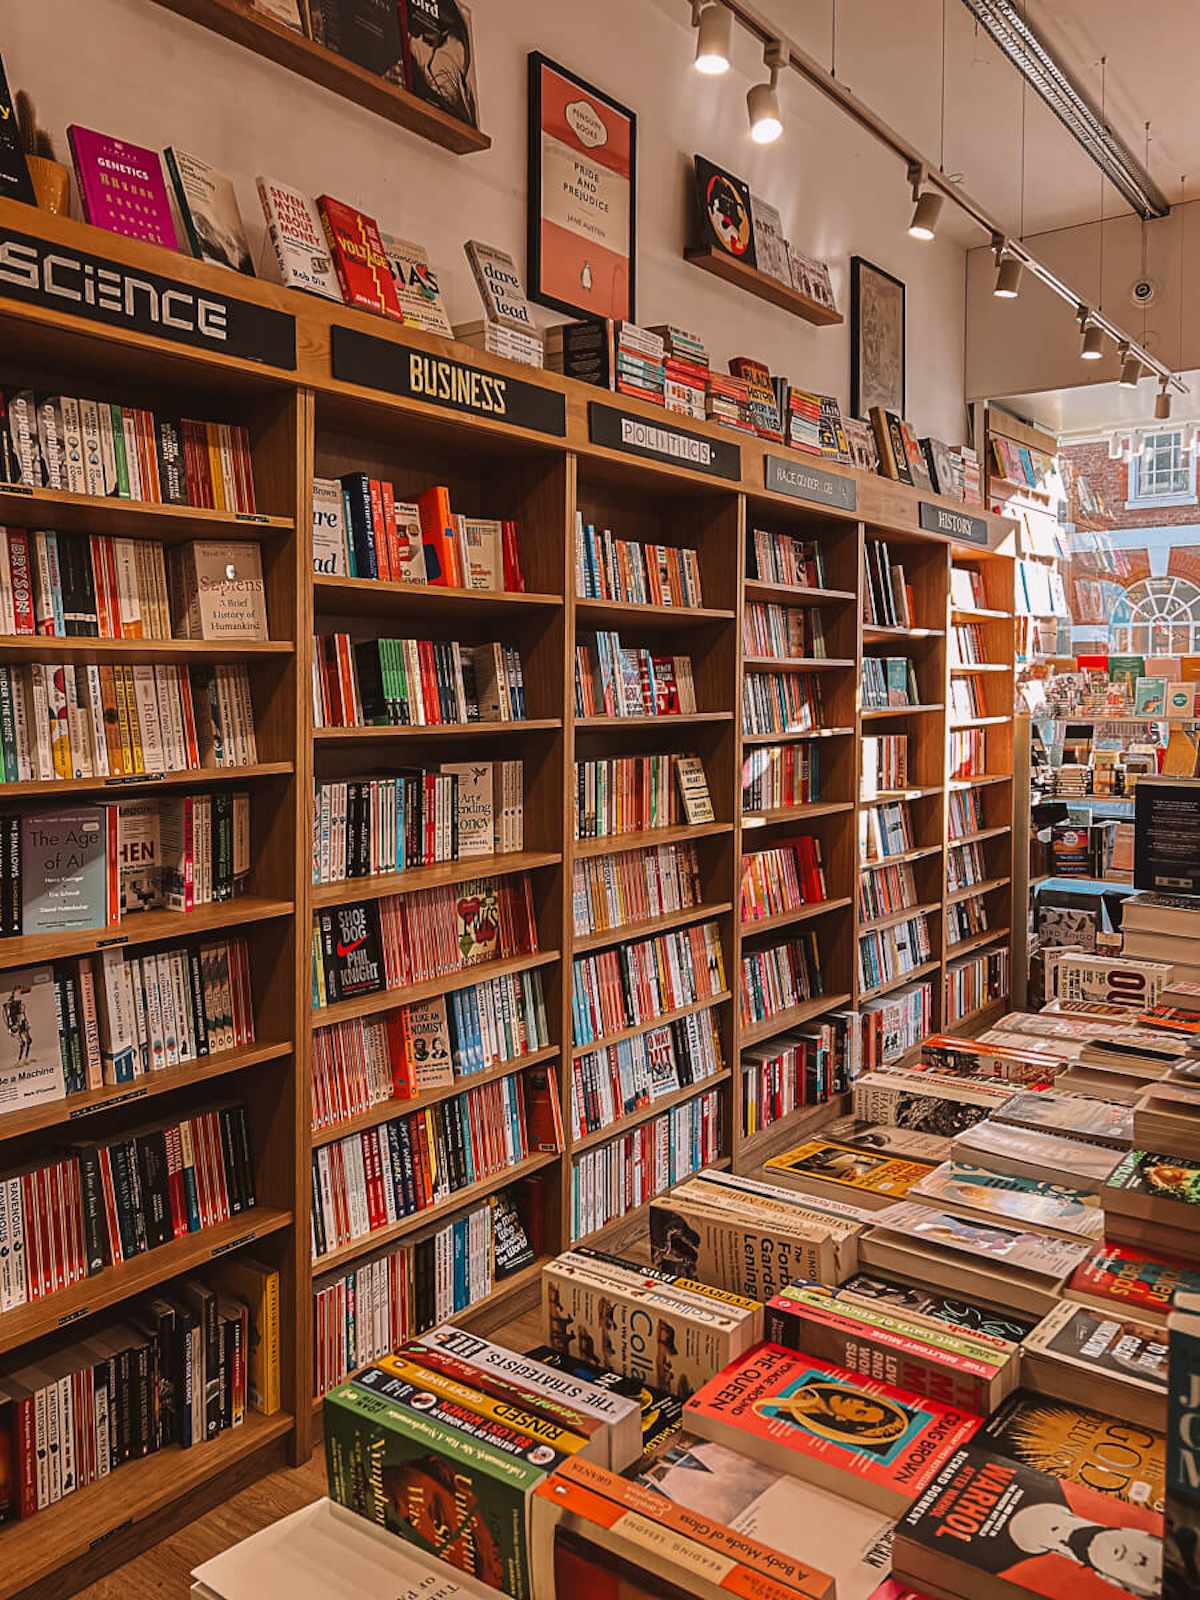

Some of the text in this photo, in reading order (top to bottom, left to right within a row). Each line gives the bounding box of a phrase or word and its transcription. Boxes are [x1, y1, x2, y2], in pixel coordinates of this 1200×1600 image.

[572, 107, 602, 131] PENGUIN
[575, 121, 598, 140] BOOKS
[97, 157, 149, 181] GENETICS
[574, 162, 600, 183] PRIDE
[270, 186, 305, 210] SEVEN
[563, 182, 610, 214] PREJUDICE
[577, 176, 597, 194] AND
[273, 199, 312, 223] MYTHS
[277, 211, 314, 235] ABOUT
[280, 222, 320, 247] MONEY
[567, 213, 606, 238] JANE AUSTEN
[337, 235, 391, 271] VOLTAGE
[484, 262, 521, 289] dare
[489, 279, 505, 297] to
[496, 297, 530, 323] lead
[409, 353, 507, 415] BUSINESS
[14, 398, 35, 486] oppenheimer
[41, 403, 62, 490] oppenheimer
[623, 420, 711, 465] POLITICS
[313, 485, 338, 498] Brown
[937, 510, 975, 536] HISTORY
[10, 543, 31, 613] BRYSON
[199, 576, 263, 597] Sapiens
[212, 610, 244, 620] History
[227, 598, 248, 608] Brief
[210, 621, 261, 631] Humankind
[0, 667, 10, 698] UNDER
[2, 699, 11, 719] THE
[142, 702, 157, 750] Behave
[457, 803, 492, 816] ending
[460, 795, 475, 805] Art
[457, 818, 490, 833] oney
[30, 831, 99, 849] The Age
[10, 832, 20, 879] SHALLOWS
[44, 853, 85, 870] of AI
[337, 908, 367, 929] SHOE
[342, 925, 367, 944] DOG
[346, 948, 371, 967] PHIL
[340, 961, 379, 986] KNIGHT
[113, 991, 123, 1023] QUANTUM
[430, 1012, 440, 1020] AN
[87, 1019, 98, 1043] ATLAS
[117, 1023, 125, 1043] STORY
[411, 1021, 443, 1035] NOMIST
[654, 1031, 670, 1046] WAY
[687, 1013, 698, 1049] PUTIN
[89, 1045, 98, 1057] OF
[18, 1067, 55, 1083] Machine
[172, 1126, 183, 1173] STATISTICAL
[388, 1124, 398, 1149] JUST
[400, 1122, 412, 1176] JUST WORK
[164, 1131, 177, 1176] STATISTICAL
[370, 1132, 381, 1177] PRICE WARS
[364, 1155, 373, 1180] WARS
[392, 1152, 402, 1182] WORK
[9, 1181, 21, 1238] RAVENOUS
[719, 1189, 758, 1208] Miller
[787, 1207, 853, 1231] Migrants
[760, 1238, 774, 1300] Garde
[807, 1248, 815, 1286] SIMO
[678, 1278, 753, 1309] EVERYDAY
[647, 1294, 715, 1323] Collared
[629, 1308, 653, 1384] Colla
[869, 1330, 903, 1345] MUSE
[936, 1336, 961, 1349] THE
[487, 1353, 583, 1402] STRATEGISTS
[708, 1348, 789, 1412] THE QUEEN
[767, 1358, 794, 1389] VOYAGE
[961, 1361, 987, 1374] THE
[362, 1396, 387, 1410] SMITH
[449, 1379, 484, 1404] GEOFF
[585, 1393, 617, 1413] THE
[731, 1384, 772, 1416] AROUND
[49, 1393, 58, 1442] METEORITES
[356, 1402, 381, 1415] JOAN
[37, 1398, 46, 1447] METEORITES
[436, 1400, 534, 1450] 80 LOST WOMEN
[492, 1404, 564, 1440] RINSED
[924, 1411, 961, 1444] CRAIG
[1050, 1414, 1104, 1479] DELUSION
[1078, 1424, 1156, 1493] GOD
[571, 1461, 612, 1487] GRANTA
[895, 1439, 937, 1487] BROWN
[939, 1450, 970, 1487] RICHARD
[951, 1464, 976, 1490] AFTER
[407, 1485, 425, 1528] Was
[904, 1484, 942, 1527] DORMENT
[933, 1461, 1018, 1544] WARHOL
[622, 1517, 722, 1572] READING LESSONS
[679, 1514, 810, 1581] A Body Made of Glass
